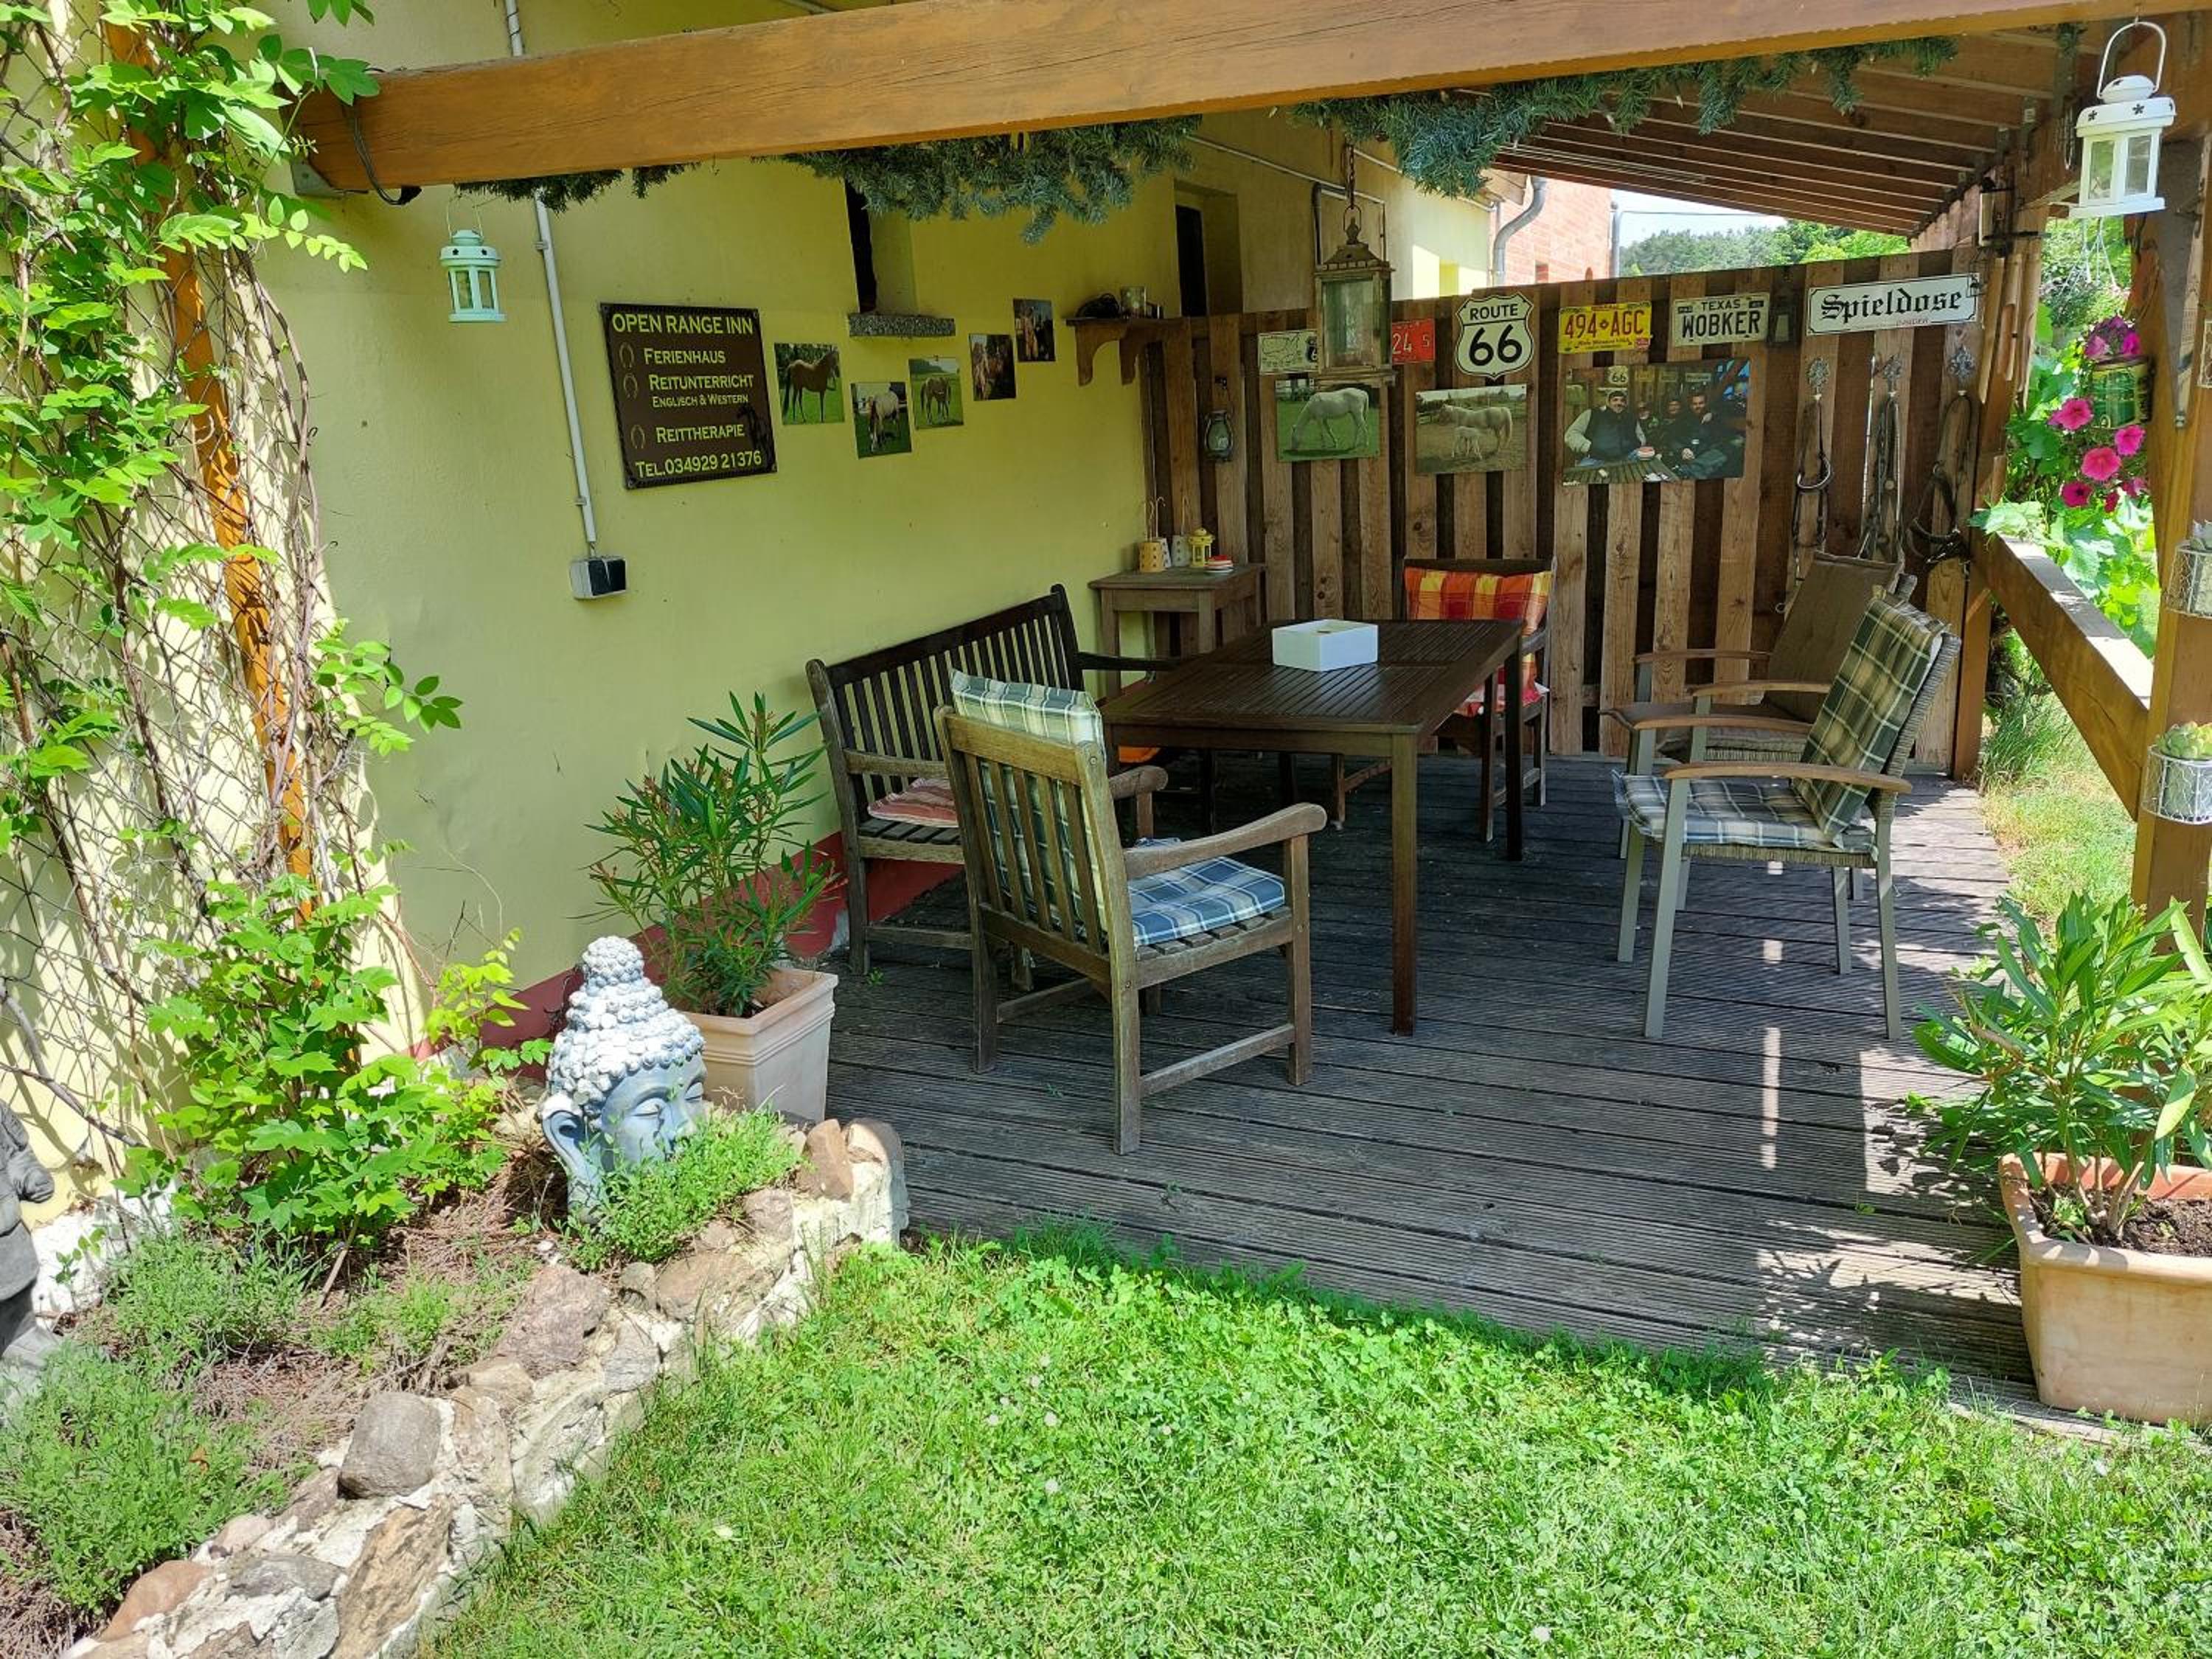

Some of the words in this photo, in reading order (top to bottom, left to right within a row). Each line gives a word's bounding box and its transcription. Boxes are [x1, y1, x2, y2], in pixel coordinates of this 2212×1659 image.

[1470, 303, 1518, 321] ROUTE
[1701, 299, 1741, 311] TEXAS
[1820, 288, 1962, 324] Spieldose
[612, 313, 662, 333] OPEN
[666, 316, 724, 334] RANGE
[726, 317, 754, 335] INN
[1565, 313, 1597, 339] 494
[1610, 310, 1645, 337] AGC
[1682, 310, 1761, 338] WOBKER
[1469, 324, 1523, 366] 66
[644, 347, 726, 365] FERIENHAUS
[648, 374, 754, 391] REITUNTERRICHT
[653, 396, 698, 408] ENGLISCH
[700, 396, 707, 405] &
[708, 394, 748, 405] WESTERN
[655, 424, 745, 444] REITTHERAPIE
[721, 451, 762, 469] 21376
